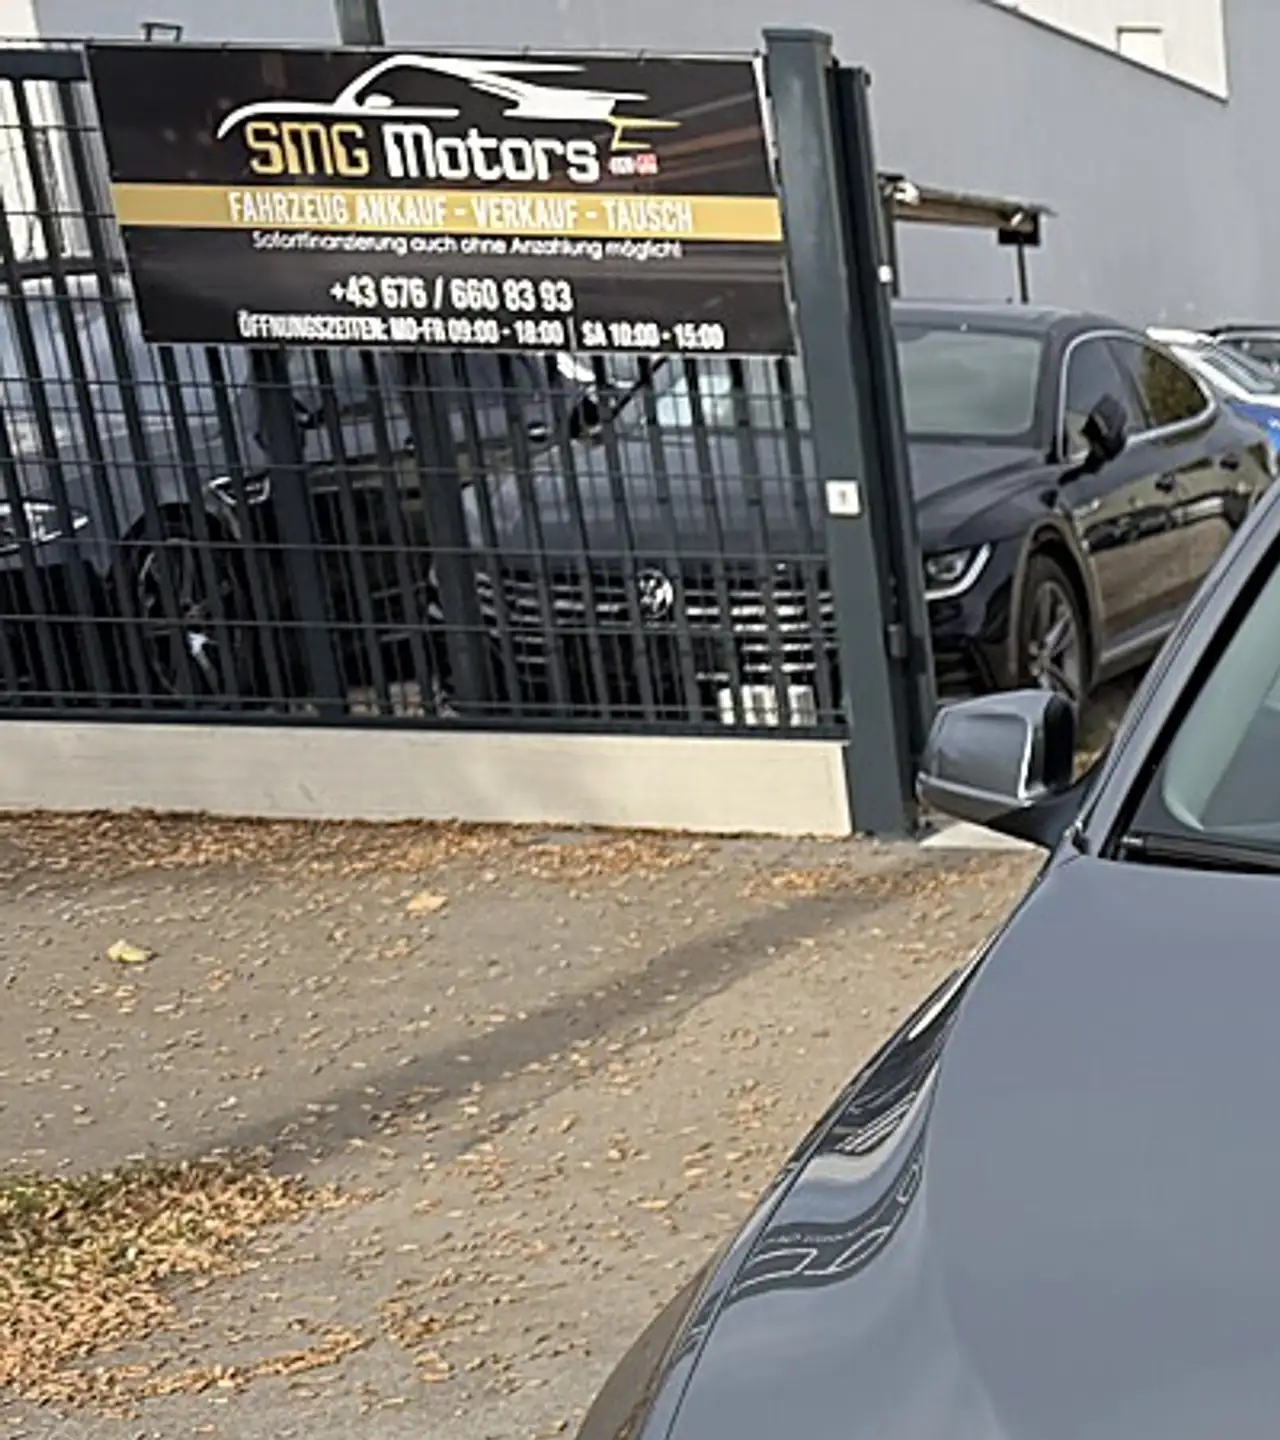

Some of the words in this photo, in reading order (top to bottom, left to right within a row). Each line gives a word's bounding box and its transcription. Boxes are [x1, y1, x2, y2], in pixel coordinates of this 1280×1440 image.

[245, 121, 370, 177] SMG
[382, 123, 600, 183] Motors
[228, 191, 349, 225] FAHRZEUG
[355, 192, 447, 227] ANKAUF
[471, 197, 578, 230] VERKAUF
[602, 199, 693, 232] TAUSCH
[252, 231, 407, 256] Sofortfinanzierung
[410, 235, 458, 254] auch
[461, 237, 506, 255] ohne
[510, 239, 602, 260] Anzahlung
[329, 275, 377, 309] +43
[381, 276, 427, 309] 676
[451, 277, 499, 310] 660
[502, 278, 536, 311] 83
[539, 279, 573, 312] 93
[450, 317, 499, 344] 09:00
[514, 319, 564, 345] 18:00
[581, 320, 607, 346] SA
[673, 323, 725, 349] 15:00
